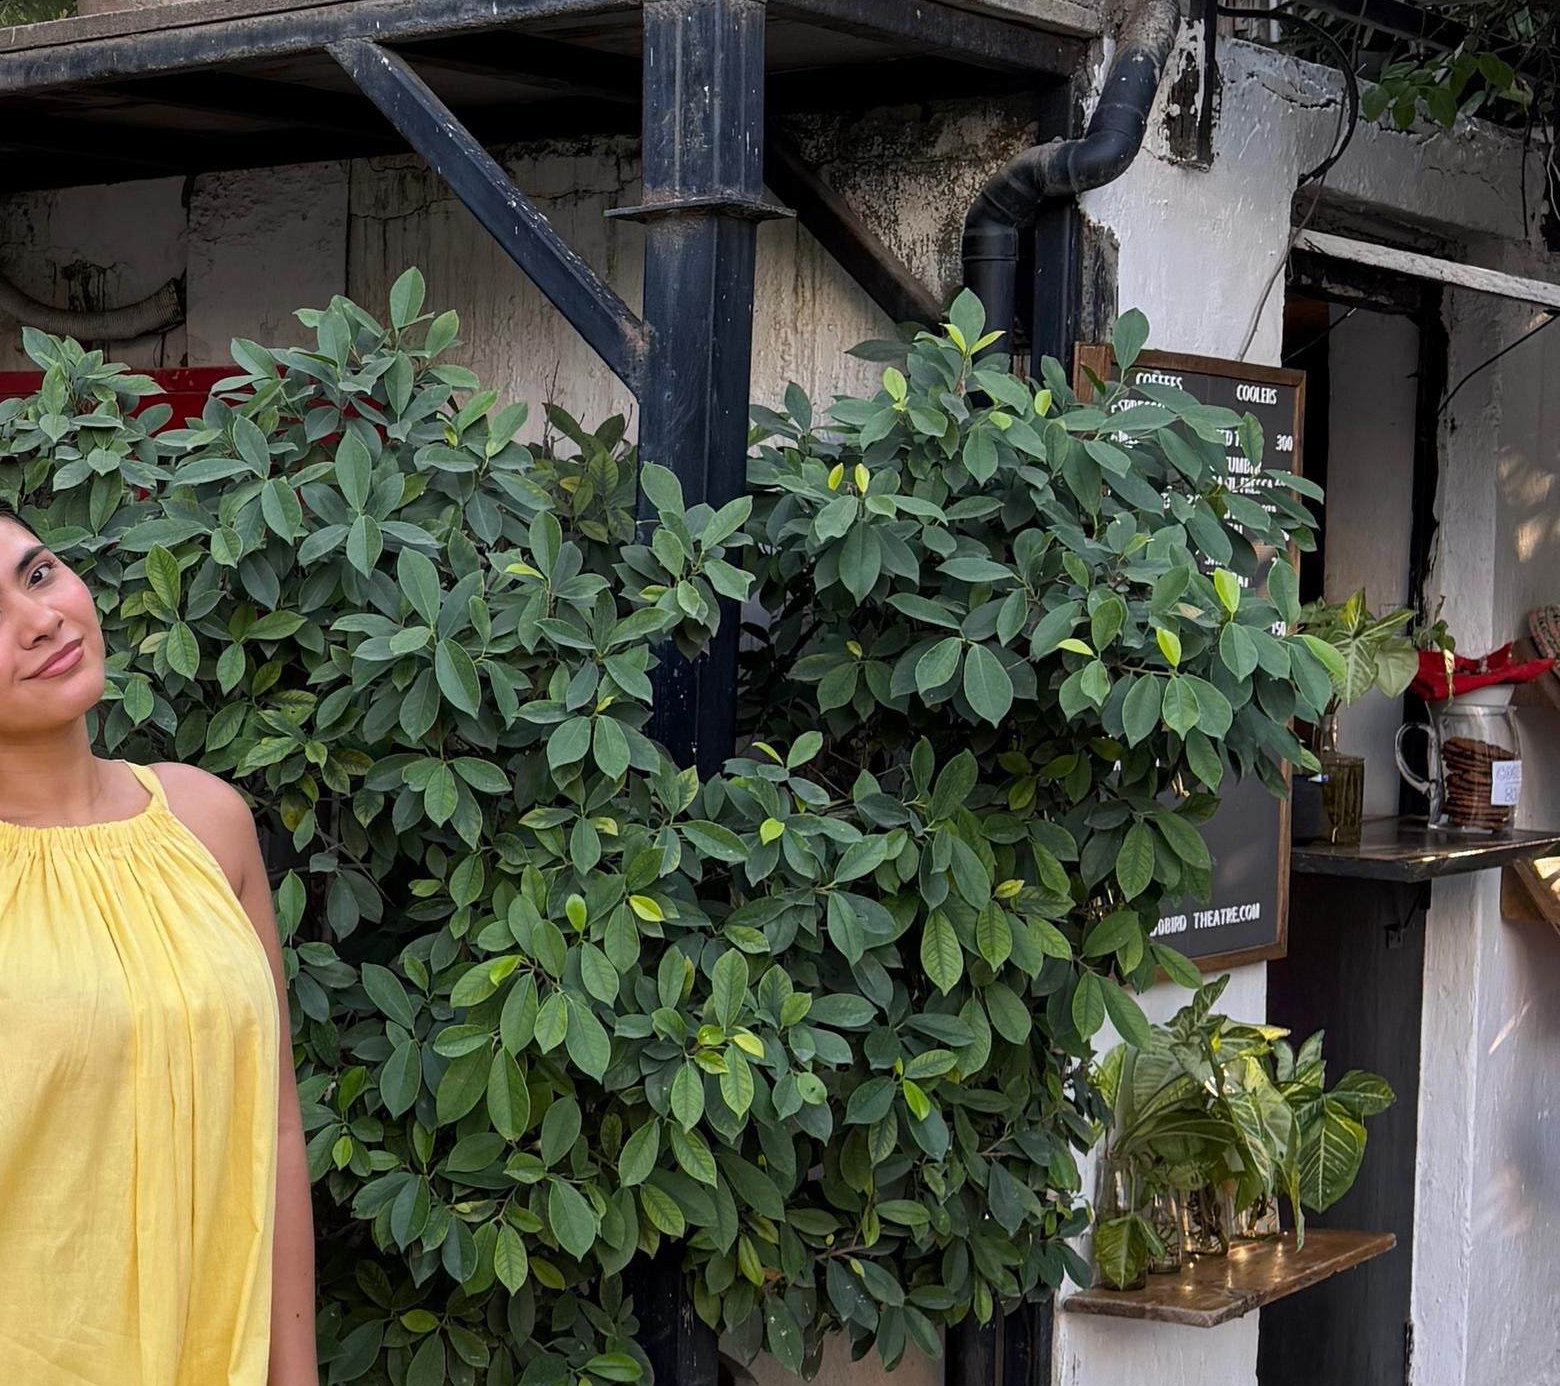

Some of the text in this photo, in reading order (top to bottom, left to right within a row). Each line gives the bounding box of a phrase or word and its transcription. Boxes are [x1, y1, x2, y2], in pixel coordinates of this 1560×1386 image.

[1236, 384, 1279, 405] COOLERS
[1275, 434, 1294, 452] 300
[1192, 902, 1261, 929] THEATRE.COM
